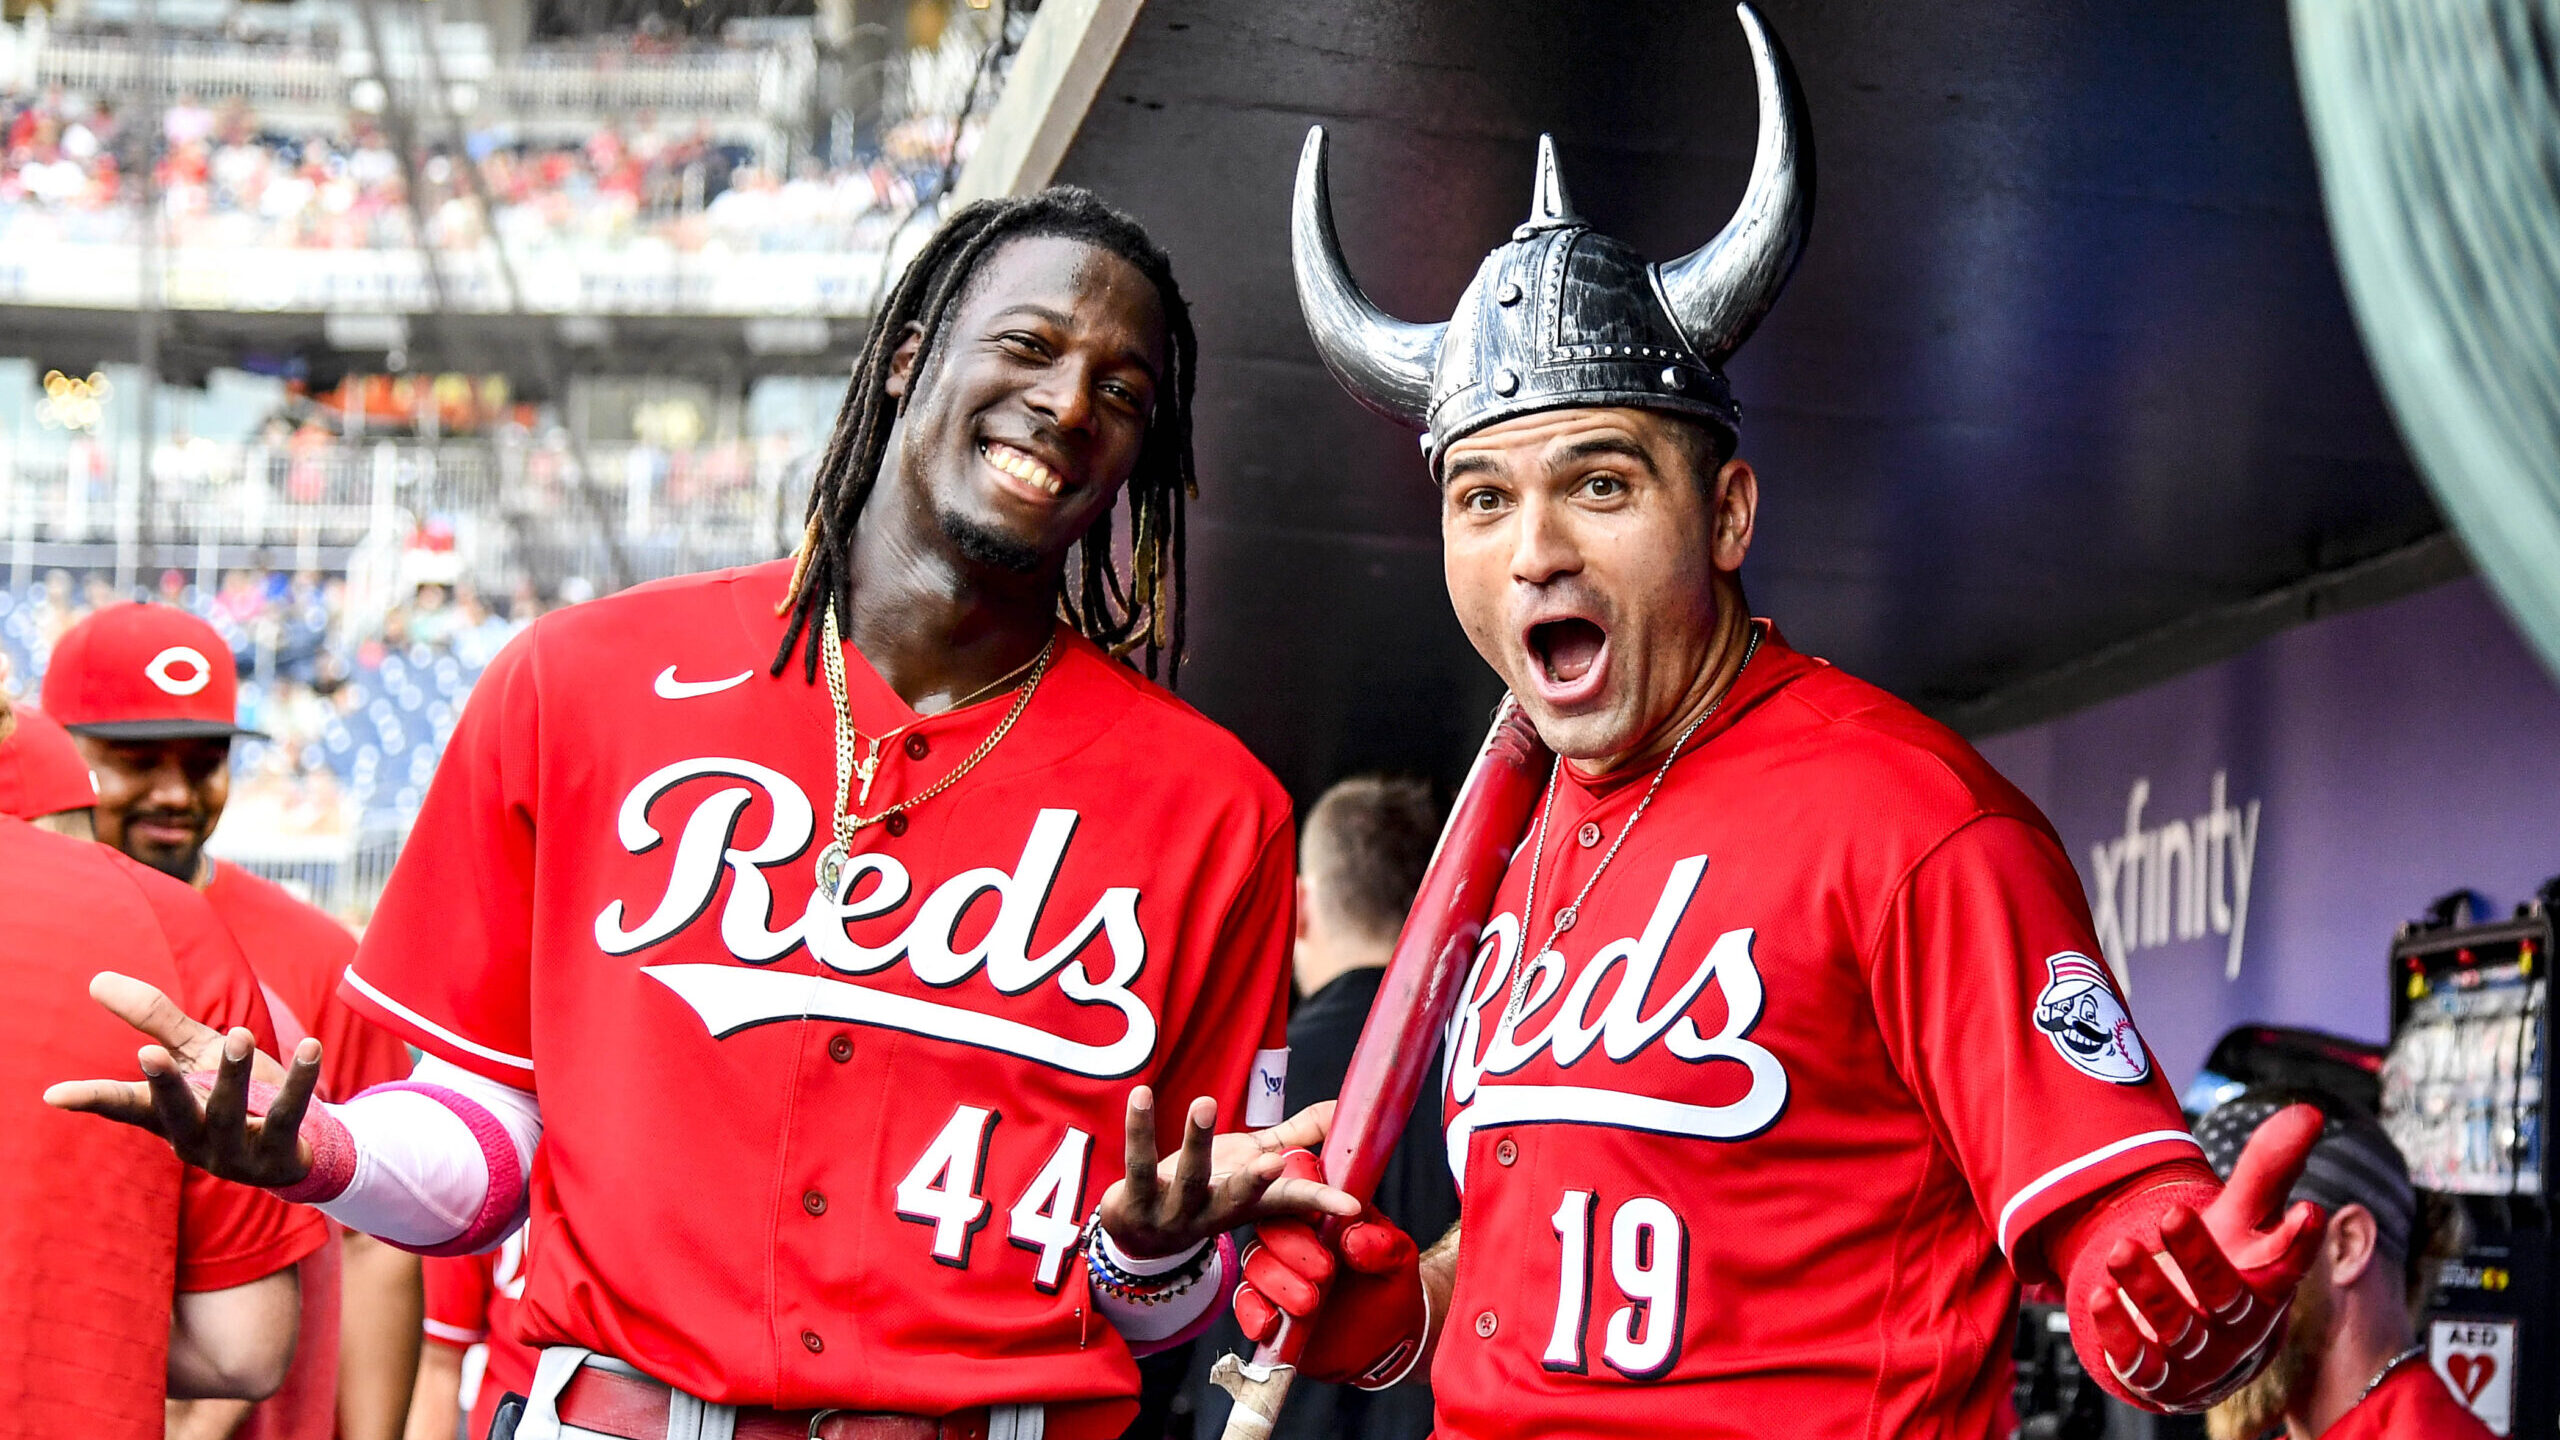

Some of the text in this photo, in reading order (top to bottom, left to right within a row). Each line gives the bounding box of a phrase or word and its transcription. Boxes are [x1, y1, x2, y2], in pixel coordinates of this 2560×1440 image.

[595, 757, 1157, 1078] Reds
[2092, 768, 2261, 998] xfinity
[1442, 854, 1790, 1143] Reds
[894, 1103, 1094, 1294] 44
[1541, 1189, 1688, 1381] 19
[2449, 1329, 2498, 1346] AED
